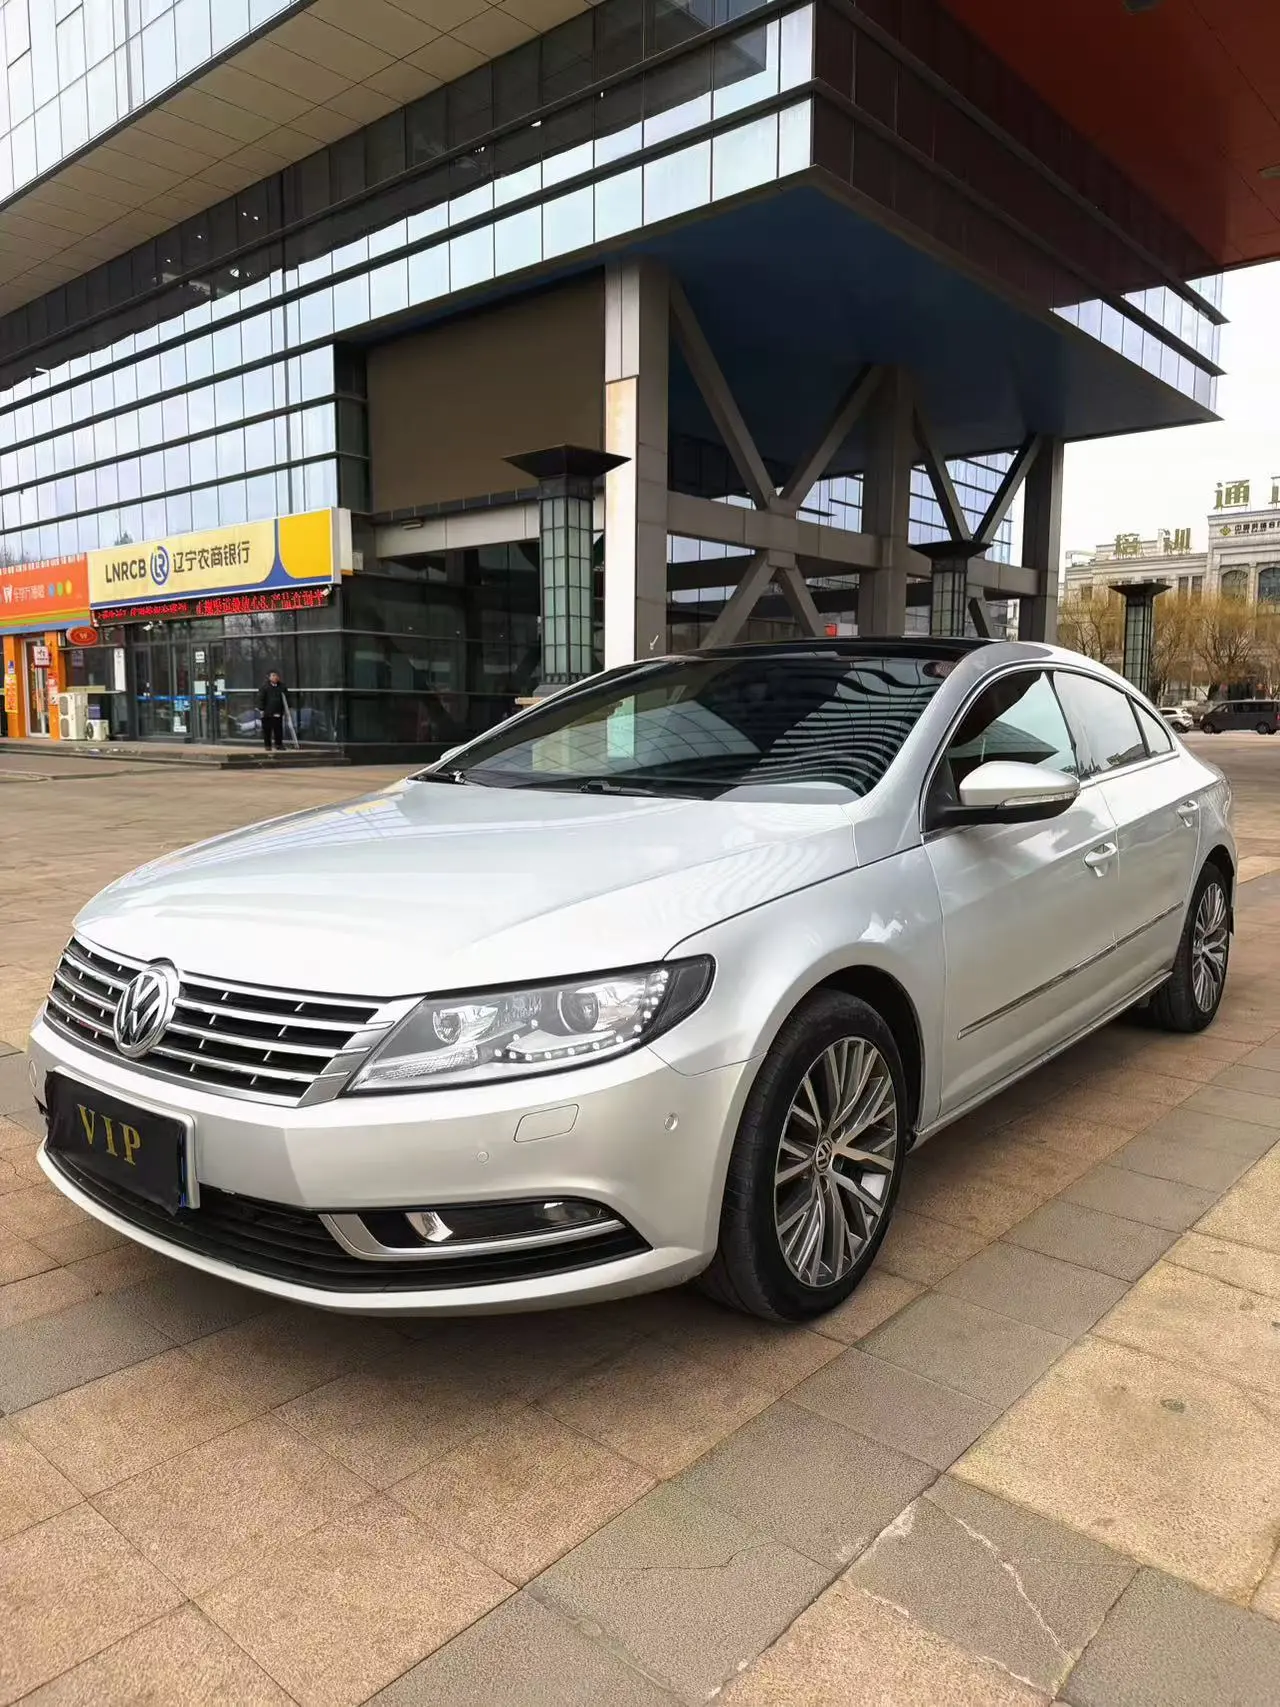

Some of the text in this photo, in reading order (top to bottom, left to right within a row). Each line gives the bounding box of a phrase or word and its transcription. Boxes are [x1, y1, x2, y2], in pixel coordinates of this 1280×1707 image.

[105, 558, 147, 583] LNRCB
[172, 541, 250, 573] 辽宁农商银行
[77, 1103, 142, 1166] VIP
